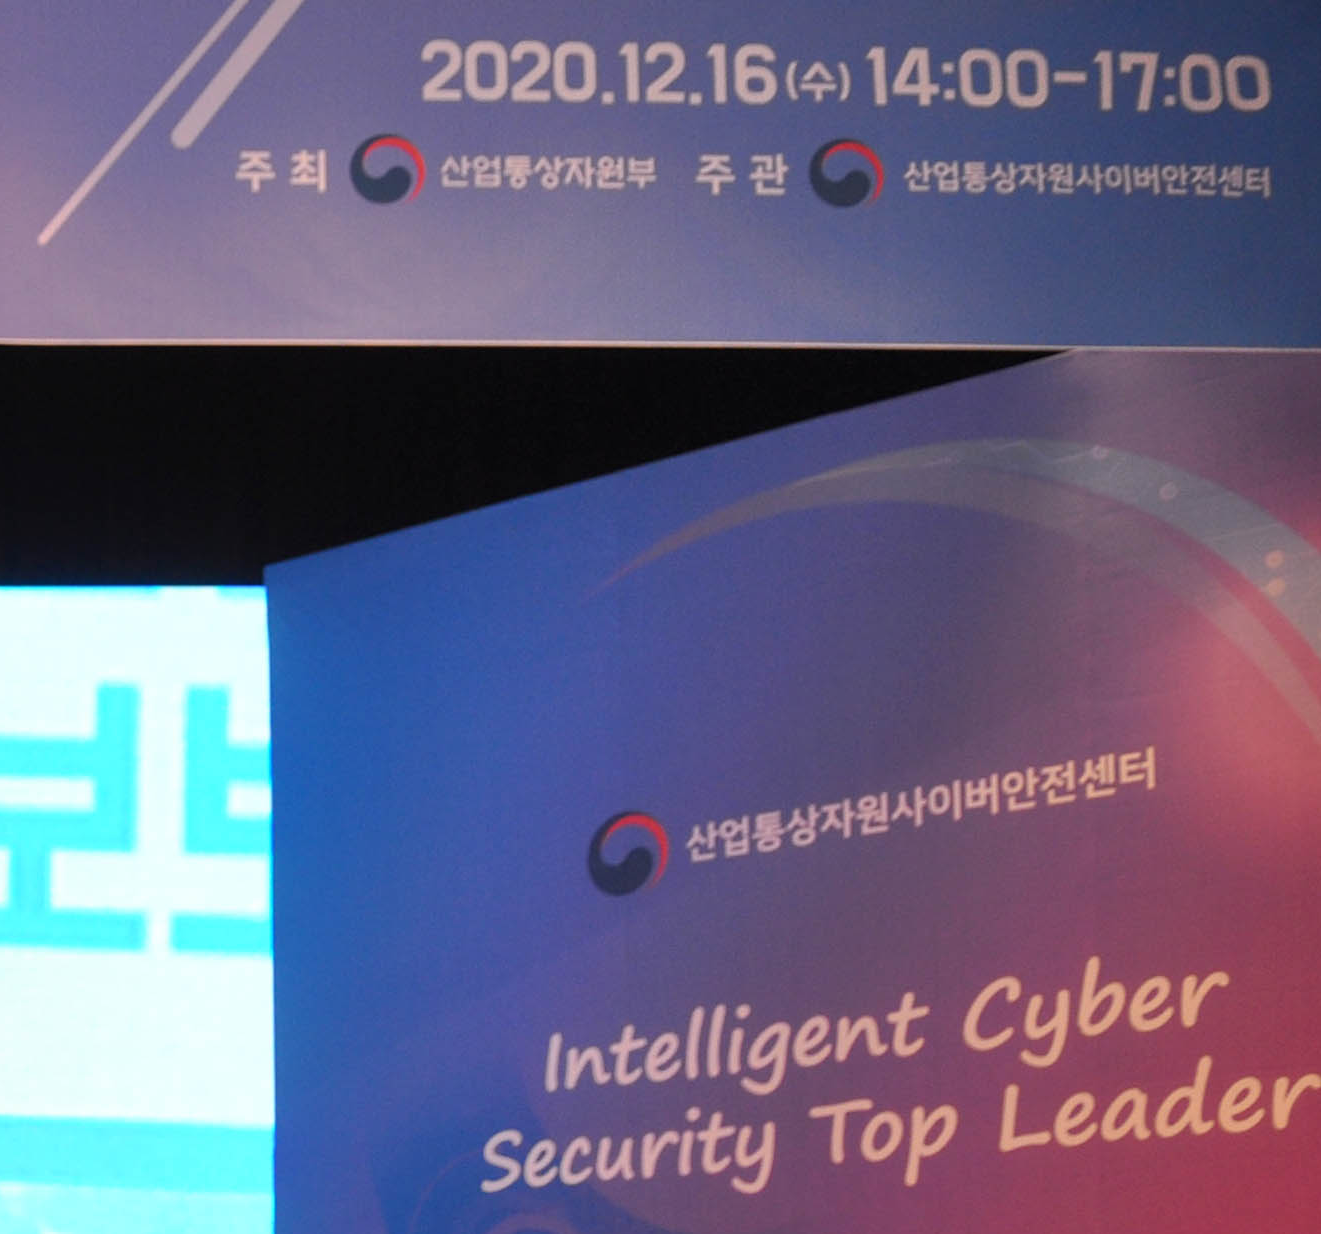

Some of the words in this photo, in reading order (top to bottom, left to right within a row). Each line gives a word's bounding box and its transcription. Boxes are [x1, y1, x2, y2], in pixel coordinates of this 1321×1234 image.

[866, 47, 1272, 113] 14:00-17:00
[440, 153, 657, 190] 산업통상자원부
[904, 160, 1272, 198] 산업통상자원사이버안전센터
[685, 747, 1158, 864] 산업통상자원사이버안전센터
[544, 992, 929, 1095] Intelligent
[961, 955, 1230, 1068] Cyber
[479, 1105, 776, 1194] Security
[809, 1098, 958, 1187] Top
[997, 1056, 1321, 1153] Leader
